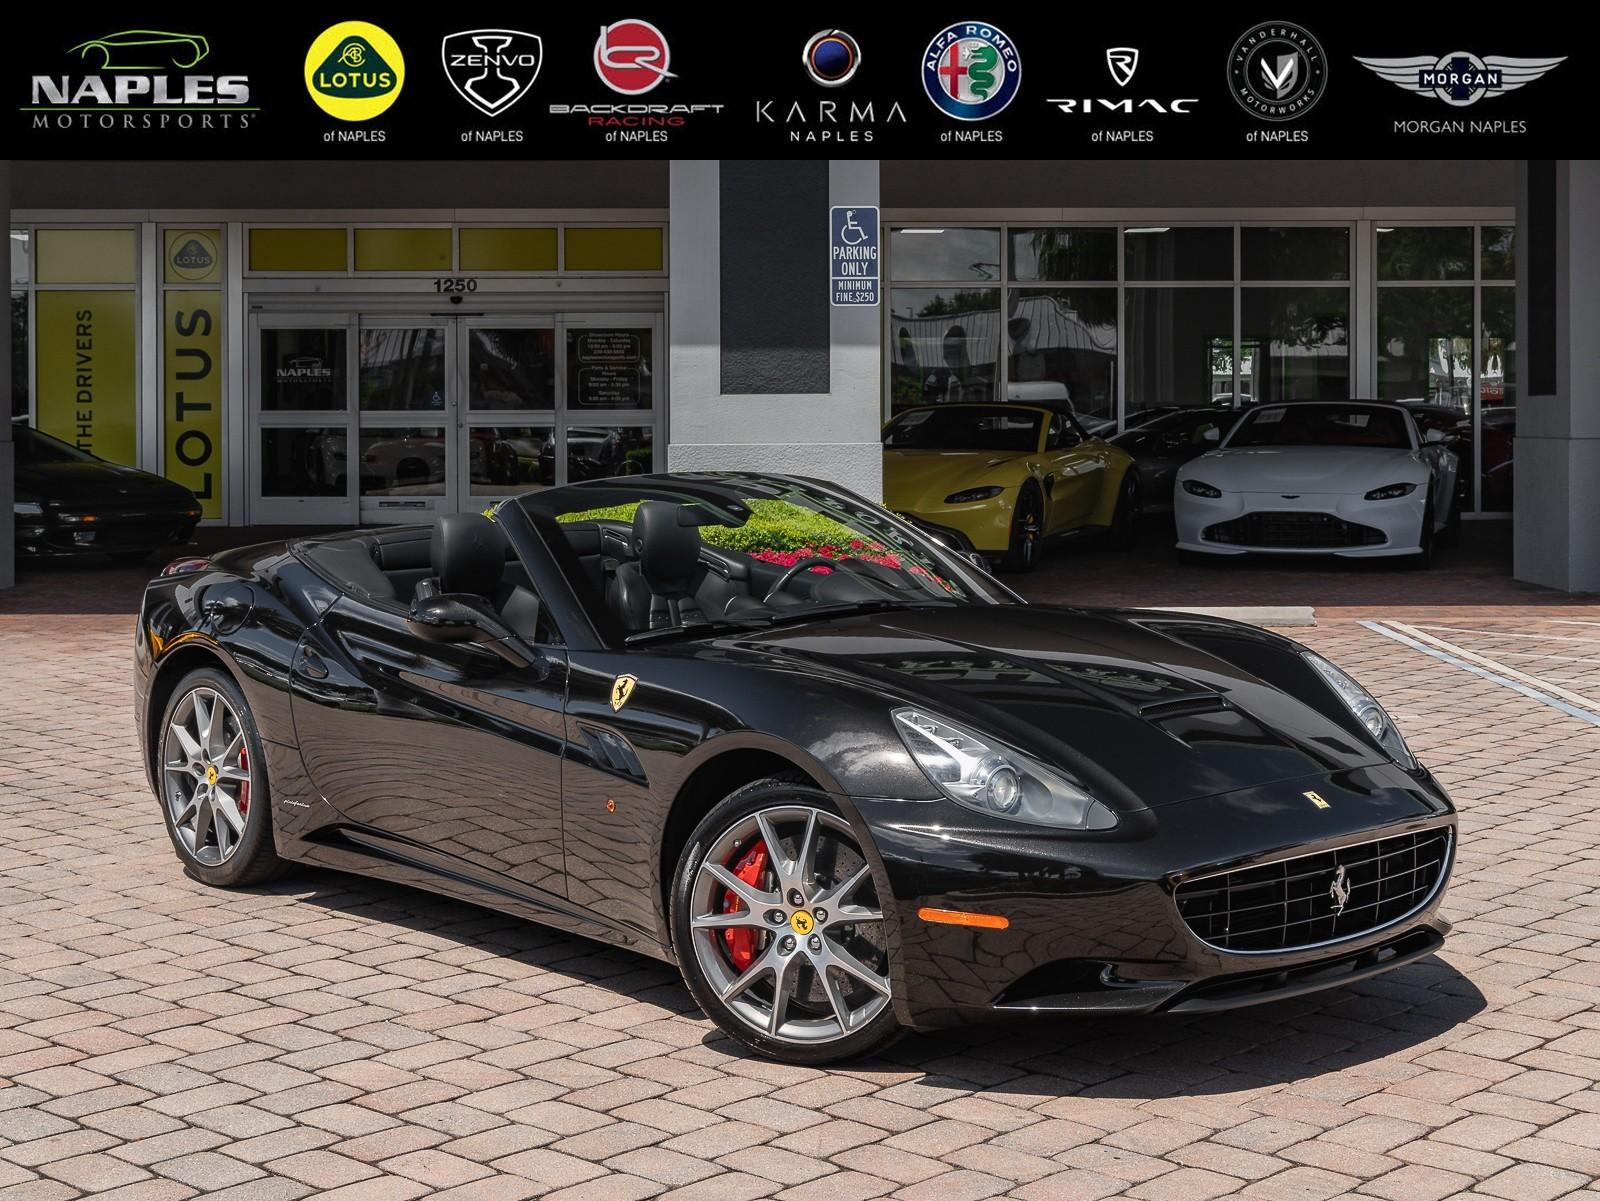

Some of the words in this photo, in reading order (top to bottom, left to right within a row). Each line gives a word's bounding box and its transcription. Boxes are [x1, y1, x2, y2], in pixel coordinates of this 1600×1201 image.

[833, 246, 877, 260] PARKING
[176, 256, 210, 265] LOTUS
[841, 262, 868, 276] ONLY
[434, 278, 477, 293] 1250
[838, 280, 872, 290] MINIMUM
[836, 292, 853, 302] FINE
[856, 292, 875, 303] $250
[76, 310, 92, 403] DRIVERS
[276, 368, 331, 376] NAPLES
[175, 309, 212, 499] LOTUS
[76, 410, 92, 451] THE
